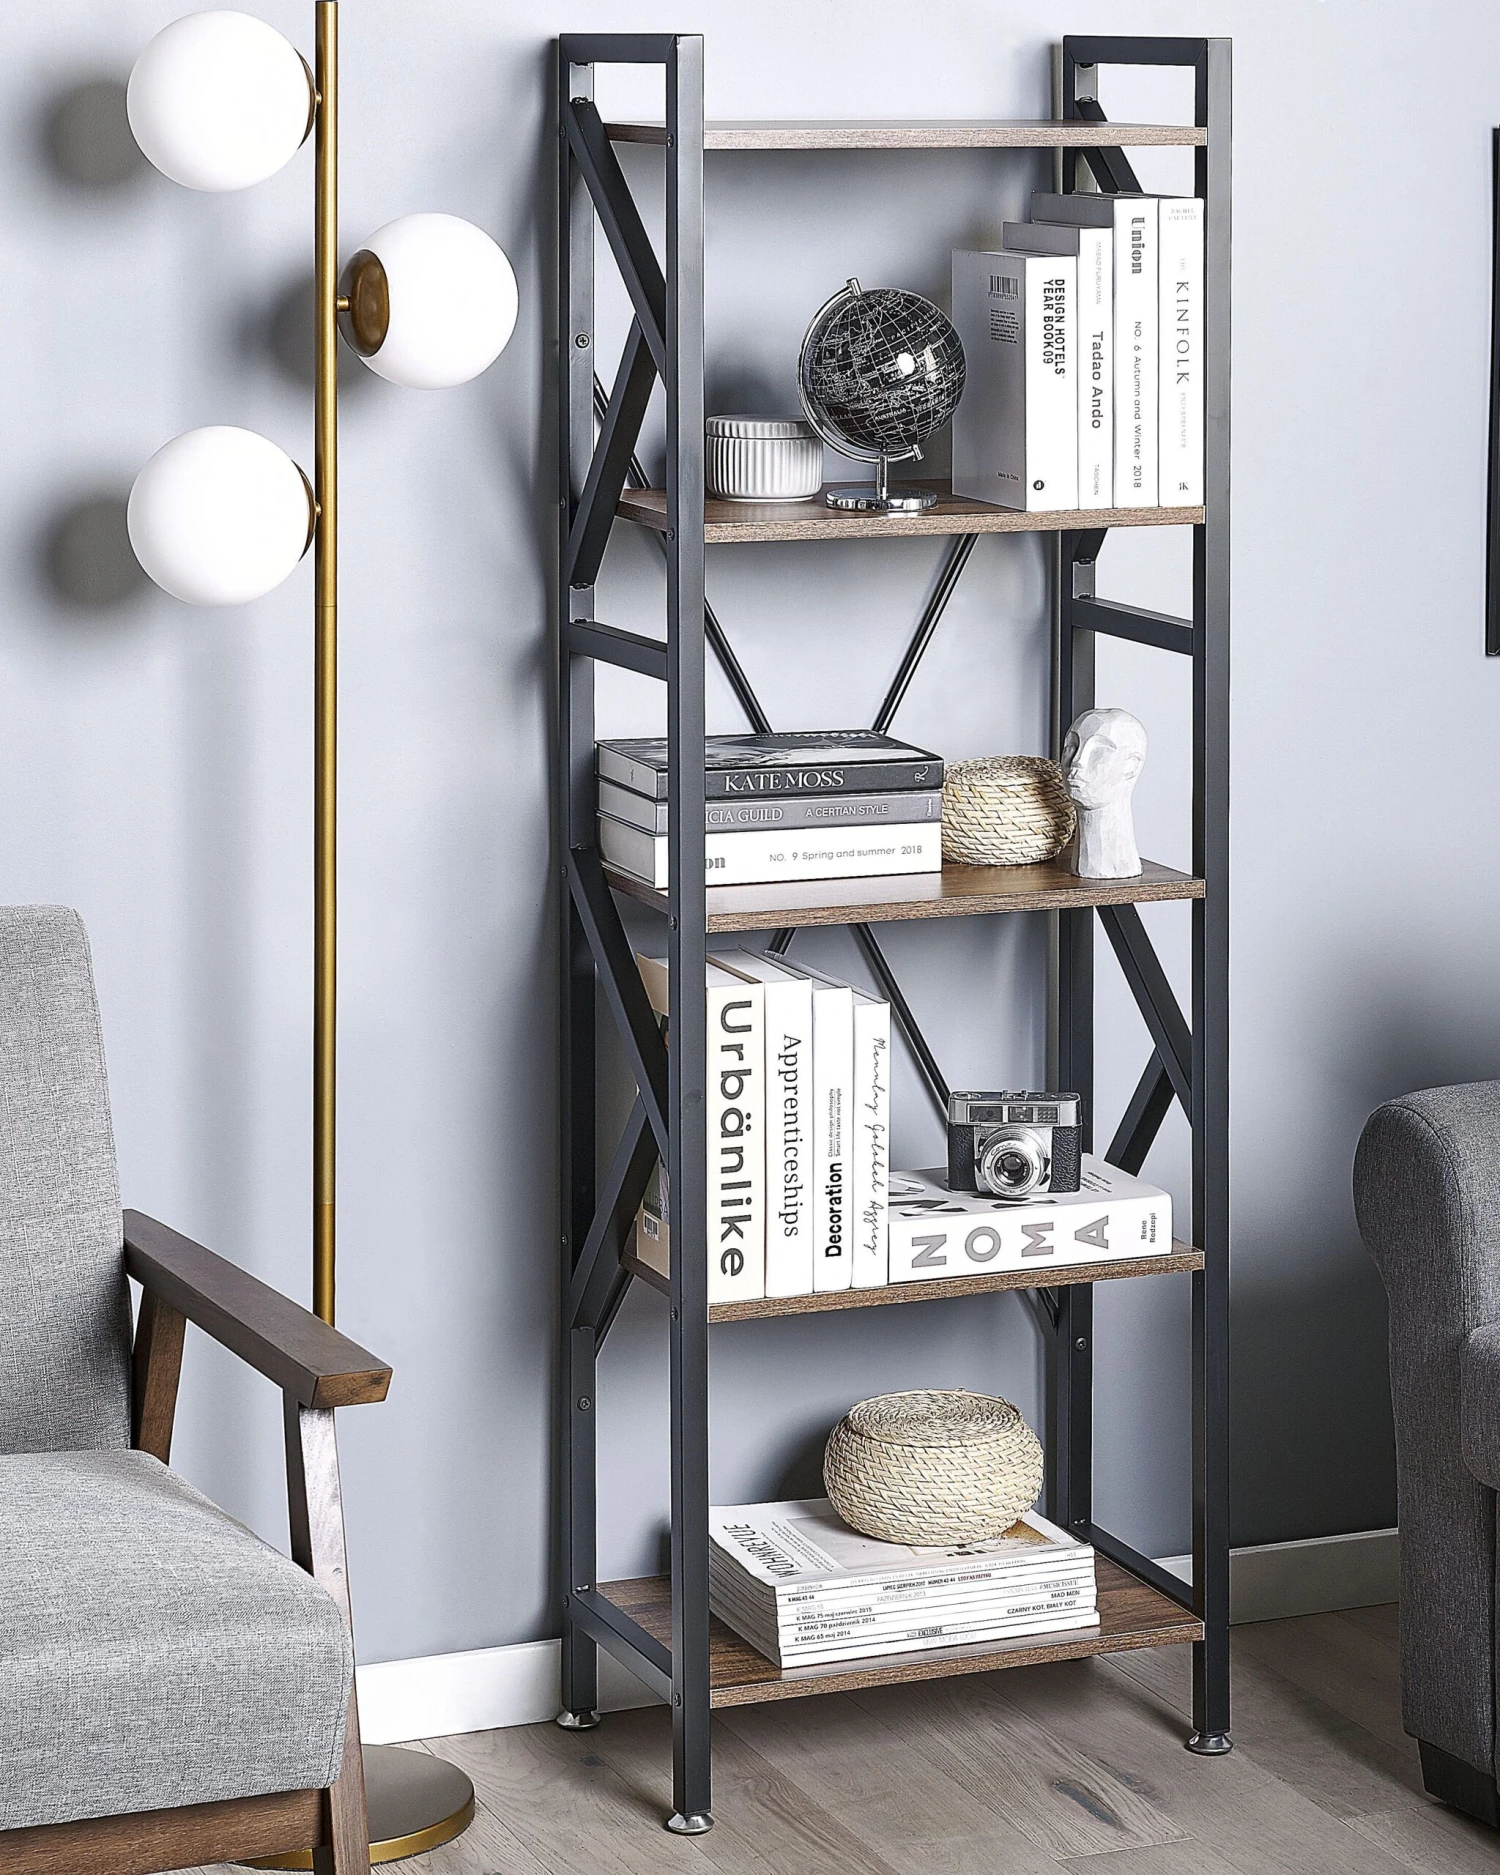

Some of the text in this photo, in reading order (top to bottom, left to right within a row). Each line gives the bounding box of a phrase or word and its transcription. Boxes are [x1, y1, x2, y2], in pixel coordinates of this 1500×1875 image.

[1132, 218, 1145, 274] Union
[1043, 279, 1054, 310] YEAR
[1055, 279, 1065, 374] DESIGN HOTELS
[1177, 282, 1189, 384] KINFOLK
[1092, 331, 1103, 428] Tadao Ando
[1134, 465, 1142, 488] 2018
[724, 770, 844, 792] KATE MOSS
[705, 807, 783, 824] ICIA GUILD
[806, 805, 887, 817] A CERTIAN STYLE
[792, 852, 798, 860] 9
[802, 851, 833, 861] Spring
[836, 849, 854, 857] and
[857, 848, 895, 856] summer
[901, 845, 922, 854] 2018
[721, 1000, 752, 1276] Urbänlike
[778, 1034, 803, 1237] Apprenticeships
[825, 1163, 842, 1257] Decoration
[911, 1215, 1109, 1268] NOMA
